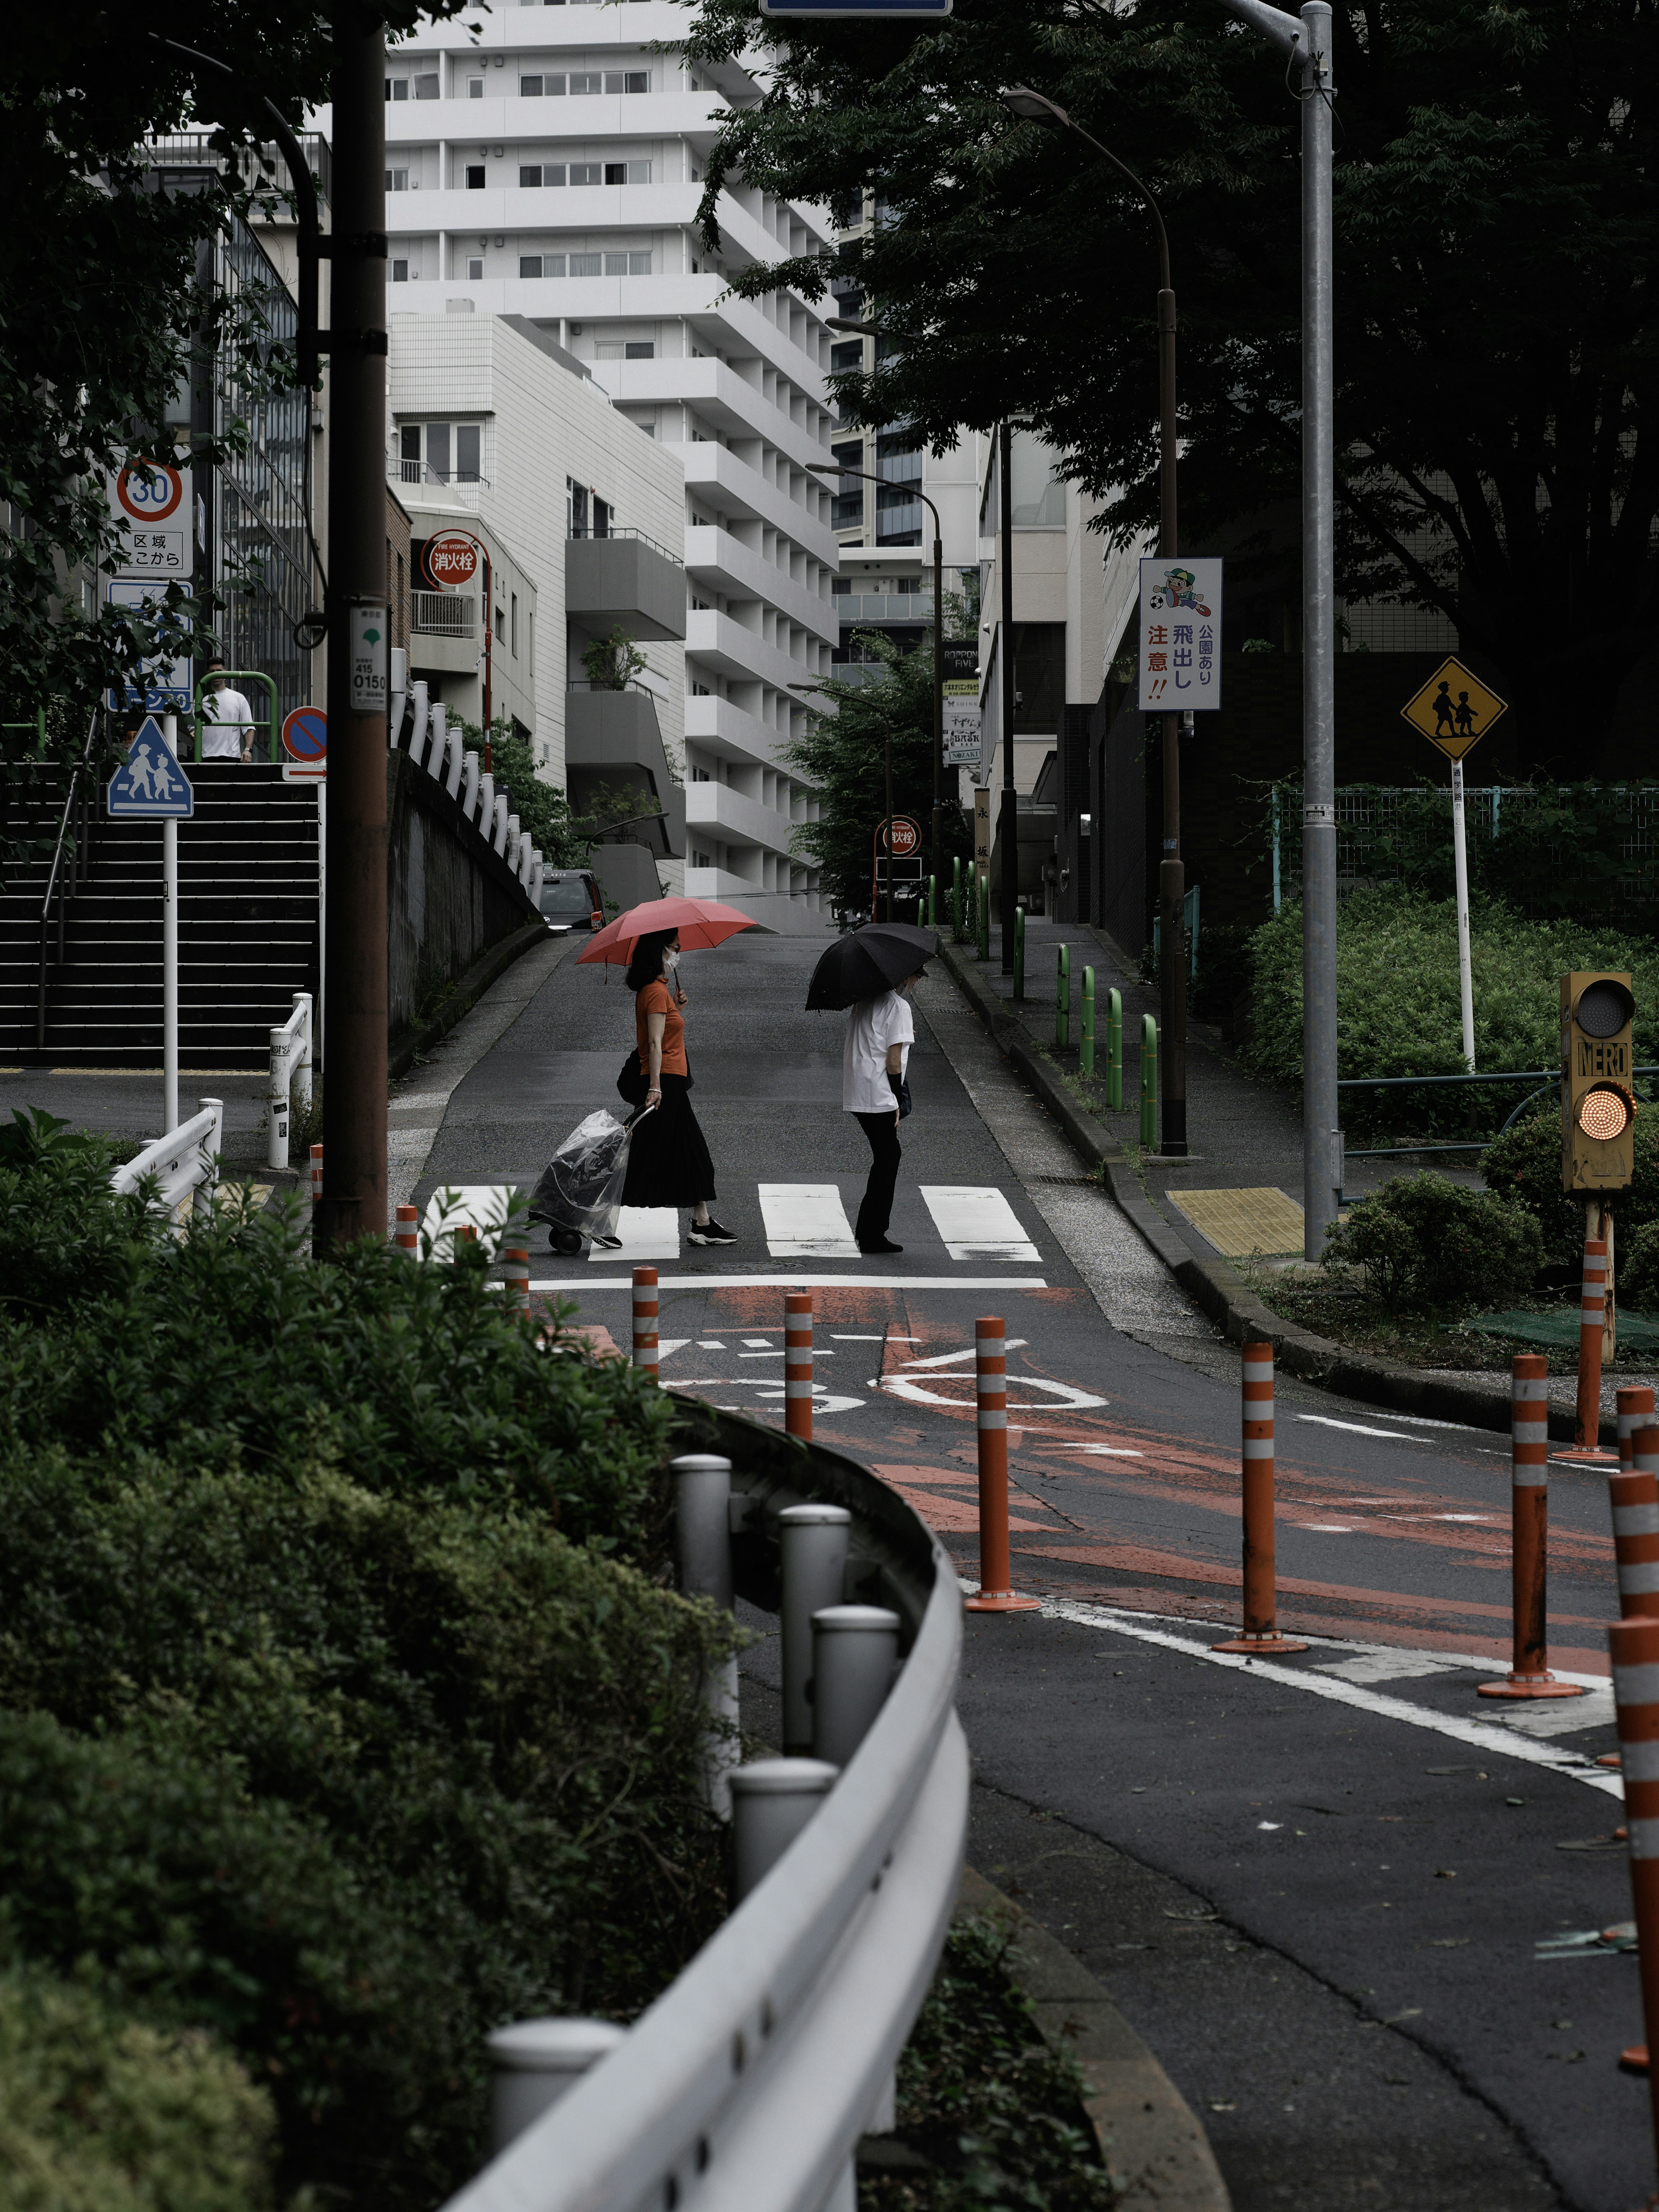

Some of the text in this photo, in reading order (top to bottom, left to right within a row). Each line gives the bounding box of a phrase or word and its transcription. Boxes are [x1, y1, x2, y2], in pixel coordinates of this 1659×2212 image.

[132, 475, 168, 503] 30
[134, 535, 166, 548] 区域
[435, 553, 474, 570] 消火栓
[944, 651, 978, 659] ROPPON
[955, 659, 974, 667] FIVE
[1173, 625, 1193, 689] 飛出し
[1199, 625, 1213, 685] 公園あり
[356, 664, 372, 673] 415
[354, 675, 385, 690] 0150
[1453, 769, 1462, 801] 通学路
[1455, 803, 1462, 825] 港区
[977, 807, 989, 857] 永坂
[1578, 1042, 1628, 1076] NERO
